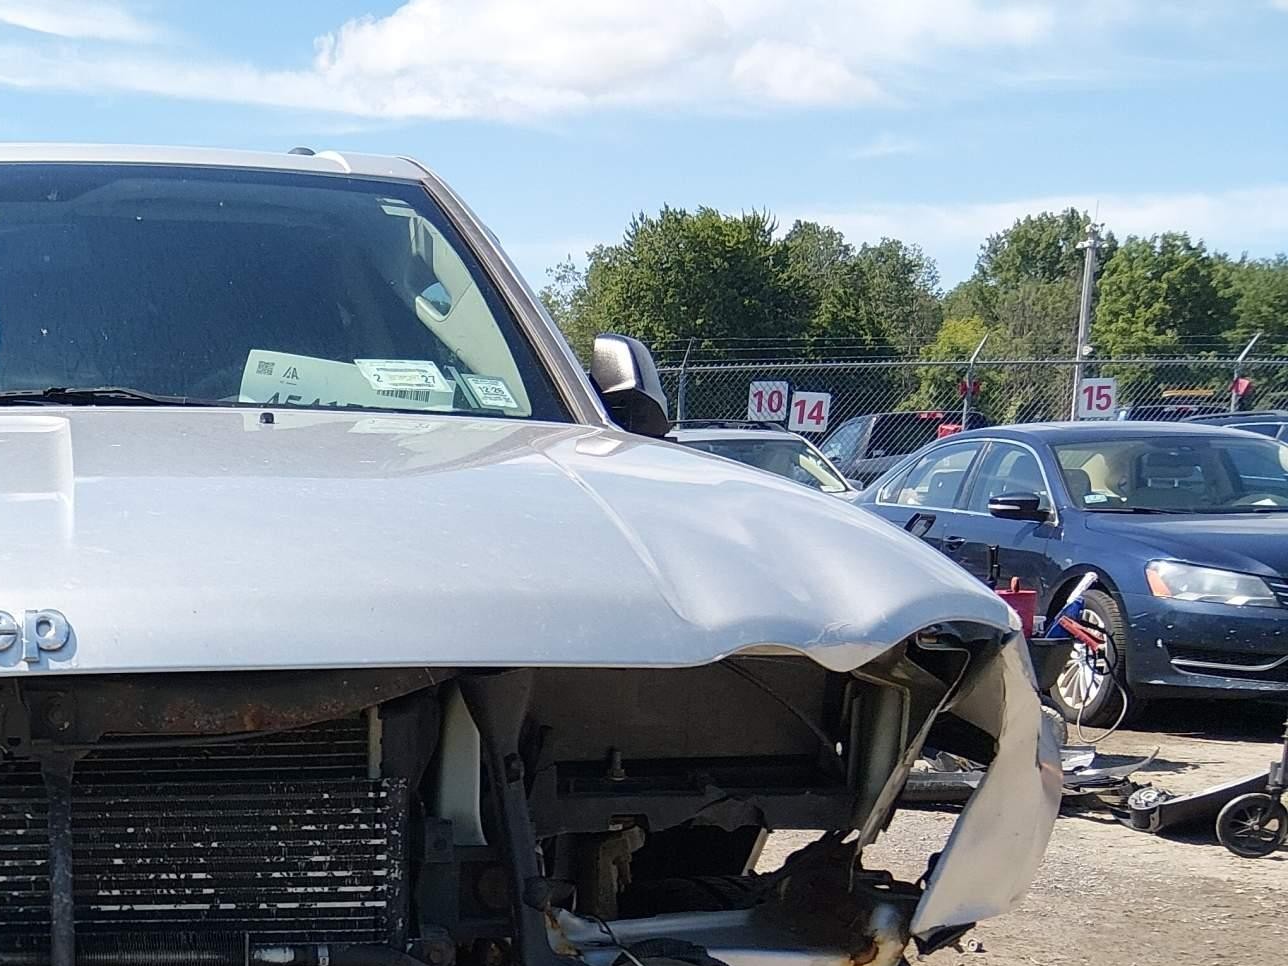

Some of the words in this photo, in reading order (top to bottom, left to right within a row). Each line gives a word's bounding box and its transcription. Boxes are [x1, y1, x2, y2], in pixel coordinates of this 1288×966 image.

[753, 388, 784, 413] 10
[1082, 385, 1112, 411] 15
[793, 399, 825, 426] 14
